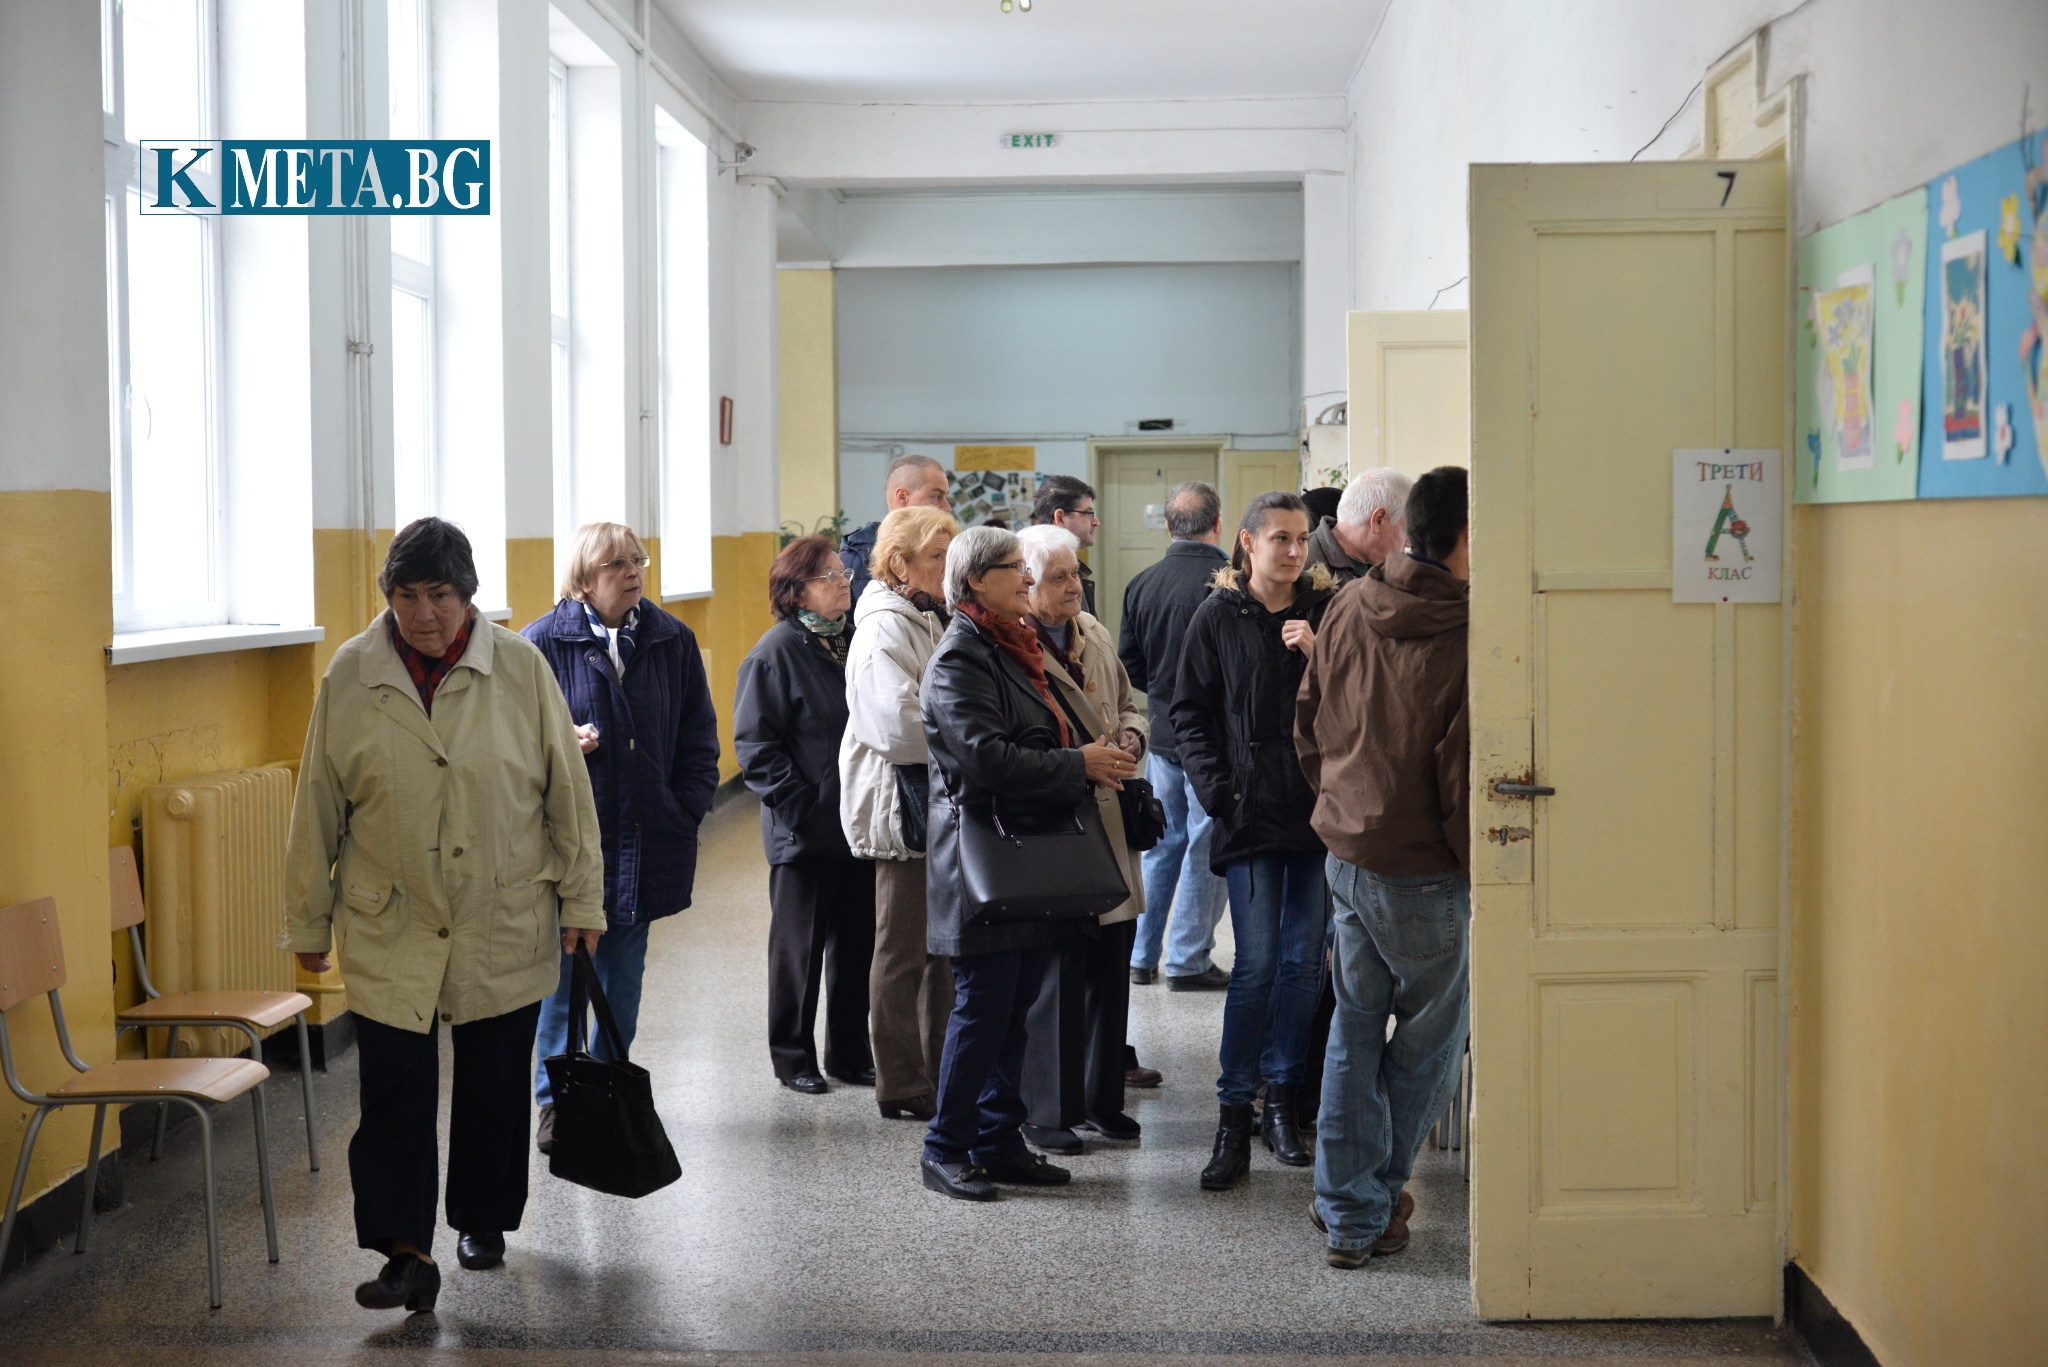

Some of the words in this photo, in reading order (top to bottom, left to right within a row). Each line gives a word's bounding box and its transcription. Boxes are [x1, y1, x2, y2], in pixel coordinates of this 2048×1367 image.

[1012, 134, 1054, 148] EXIT
[1716, 171, 1737, 208] 7
[1696, 460, 1766, 483] ТРЕТИ
[1707, 566, 1753, 581] КЛАС
